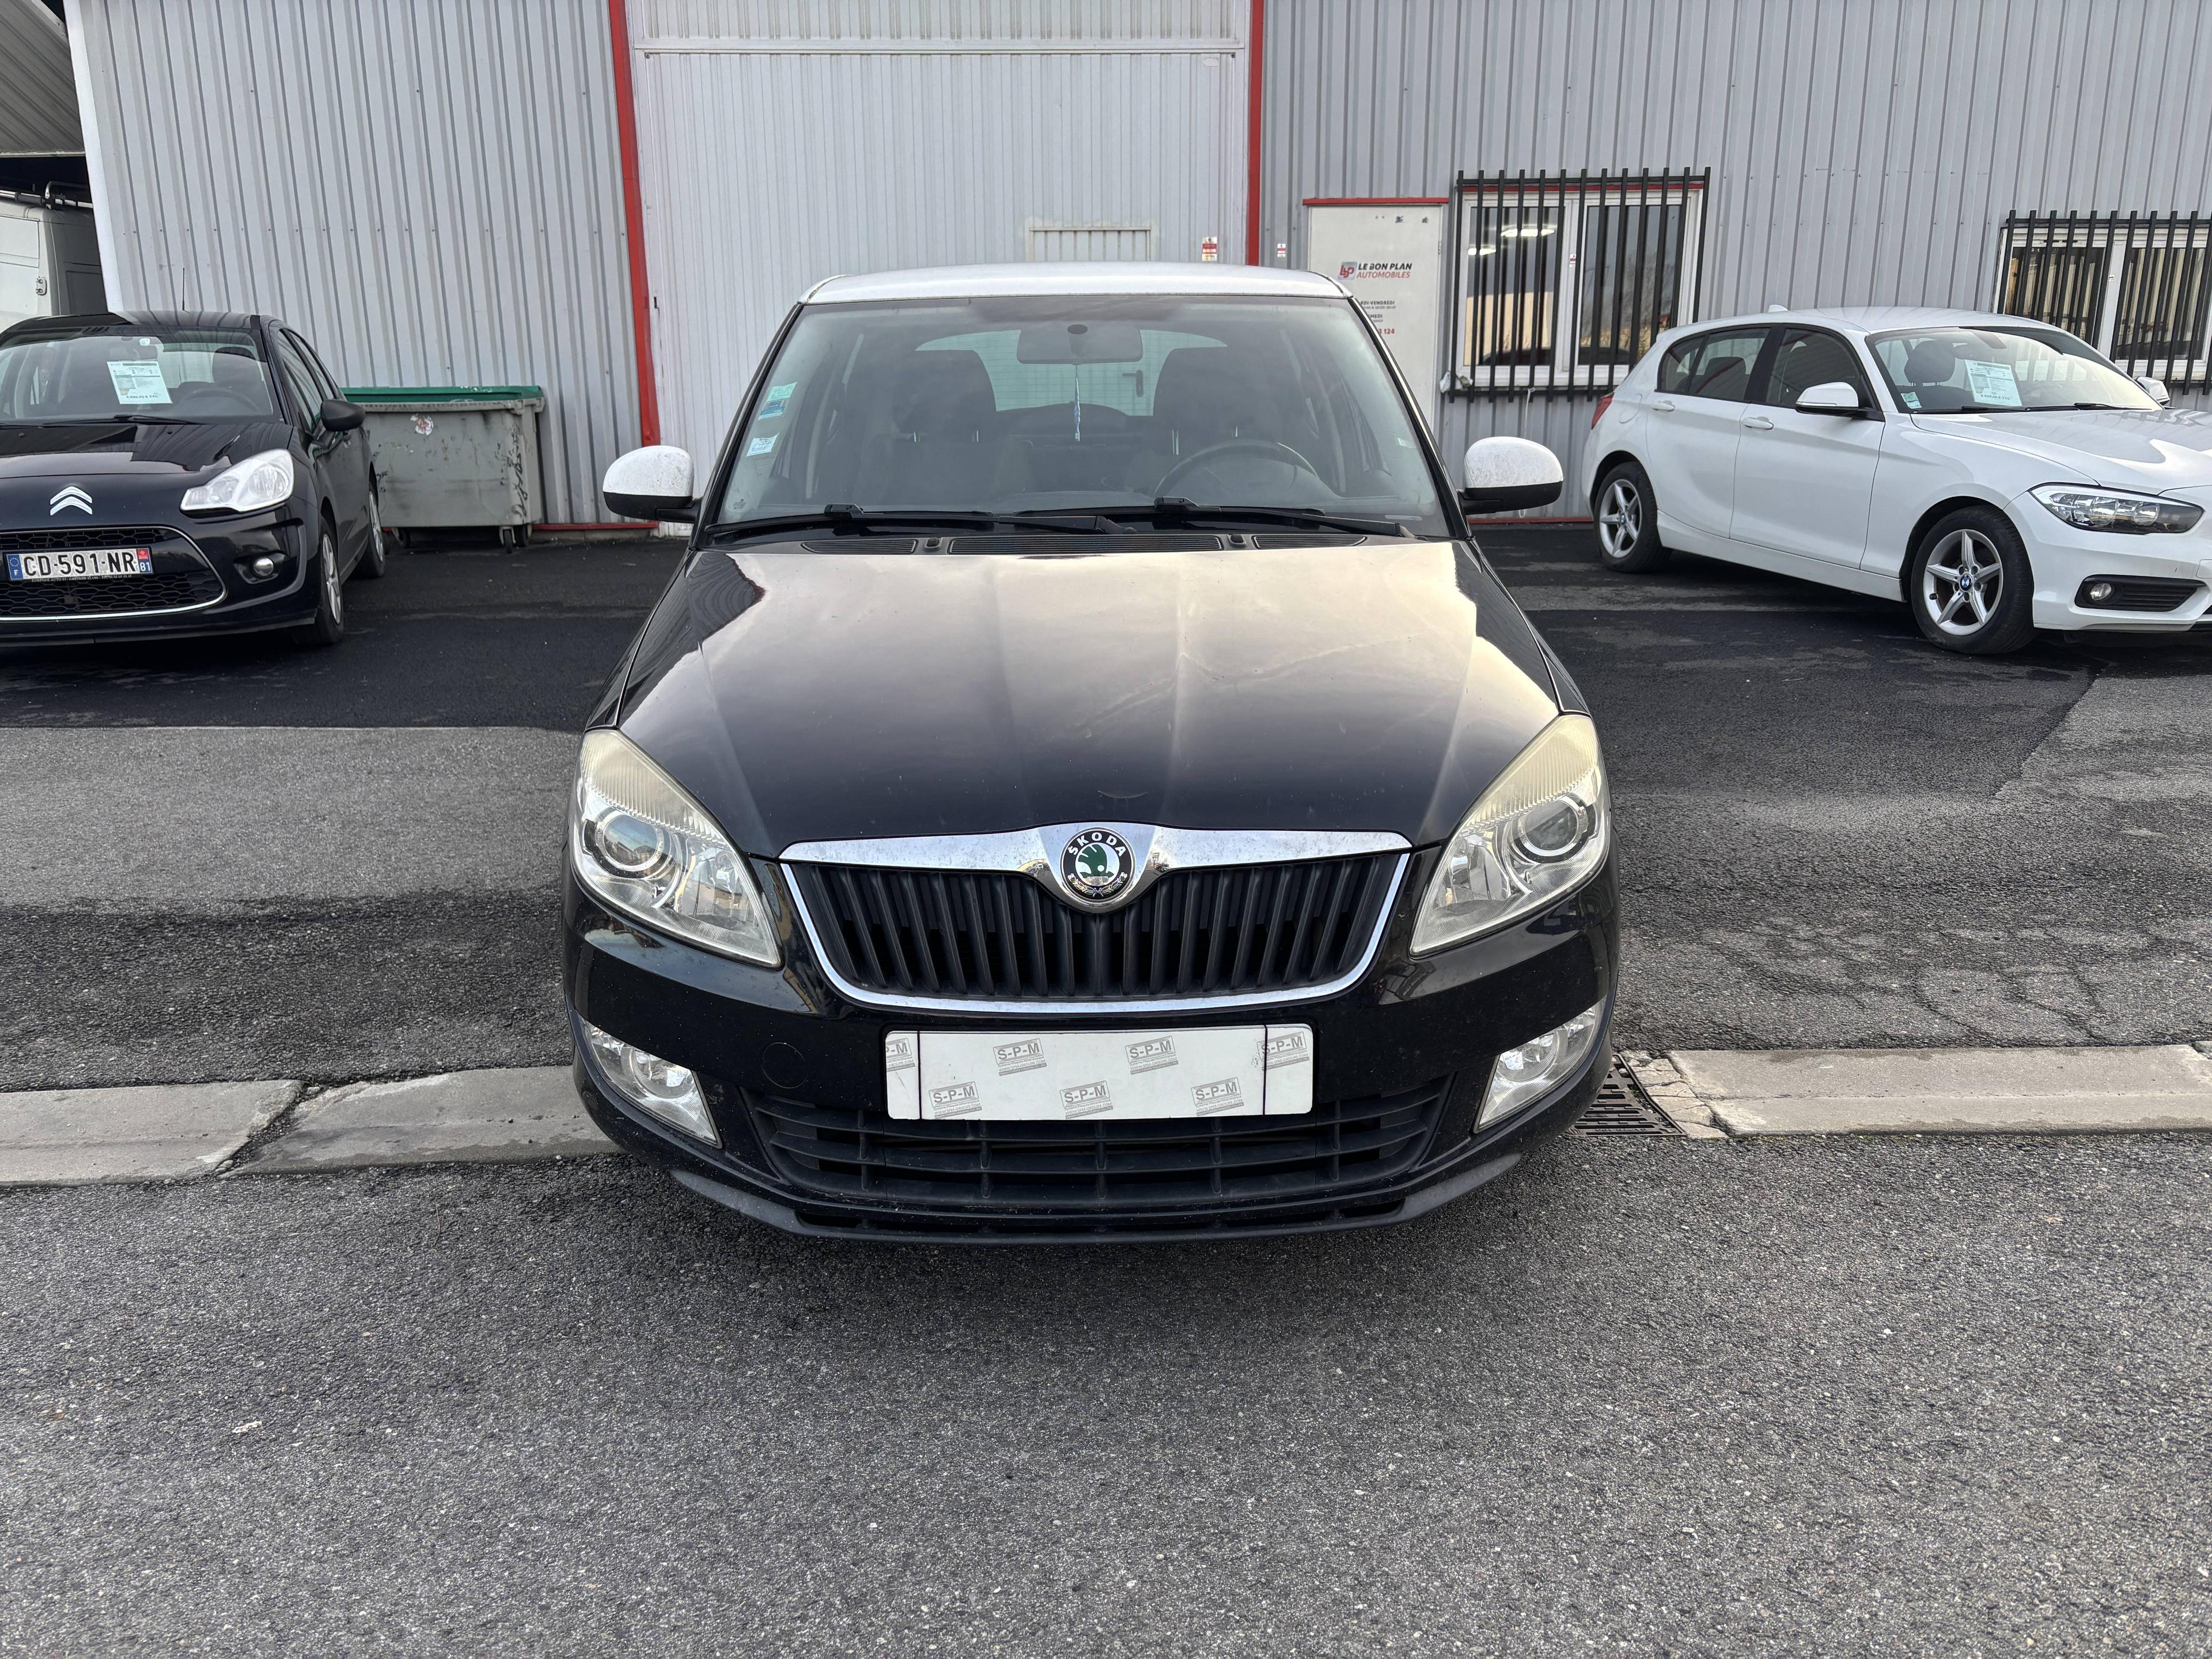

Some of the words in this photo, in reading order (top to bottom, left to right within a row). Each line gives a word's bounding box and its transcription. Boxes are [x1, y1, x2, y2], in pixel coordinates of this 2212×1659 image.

[24, 552, 136, 576] CD-591-NR
[140, 562, 151, 571] 81
[998, 1043, 1040, 1060] S-P-M
[1130, 1040, 1172, 1058] S-P-M
[933, 1085, 975, 1103] S-P-M
[1065, 1085, 1106, 1103] S-P-M
[1195, 1082, 1237, 1100] S-P-M
